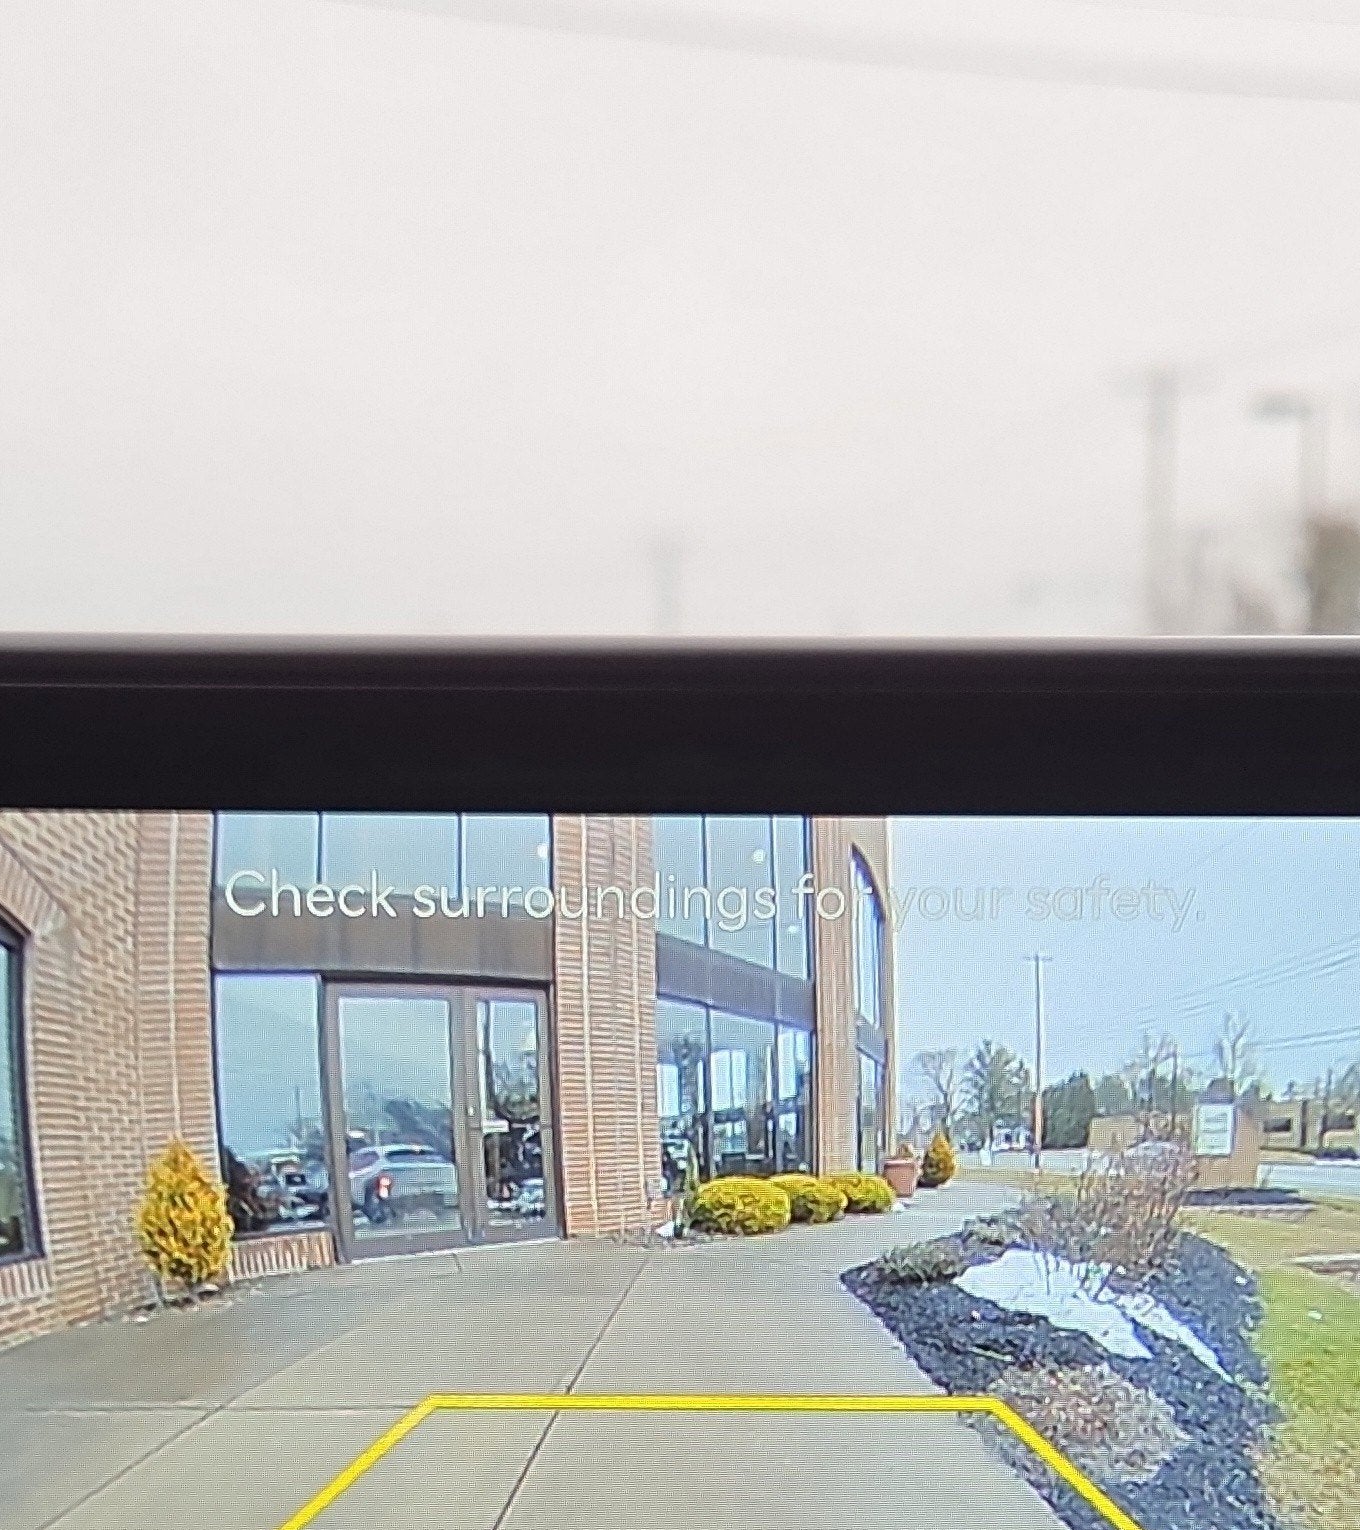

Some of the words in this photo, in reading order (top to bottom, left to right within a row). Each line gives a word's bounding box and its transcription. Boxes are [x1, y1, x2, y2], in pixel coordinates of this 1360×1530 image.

[224, 868, 398, 918] Check
[411, 870, 777, 931] surroundings
[791, 873, 873, 920] for
[886, 884, 1014, 932] your
[1024, 874, 1207, 932] safety.
